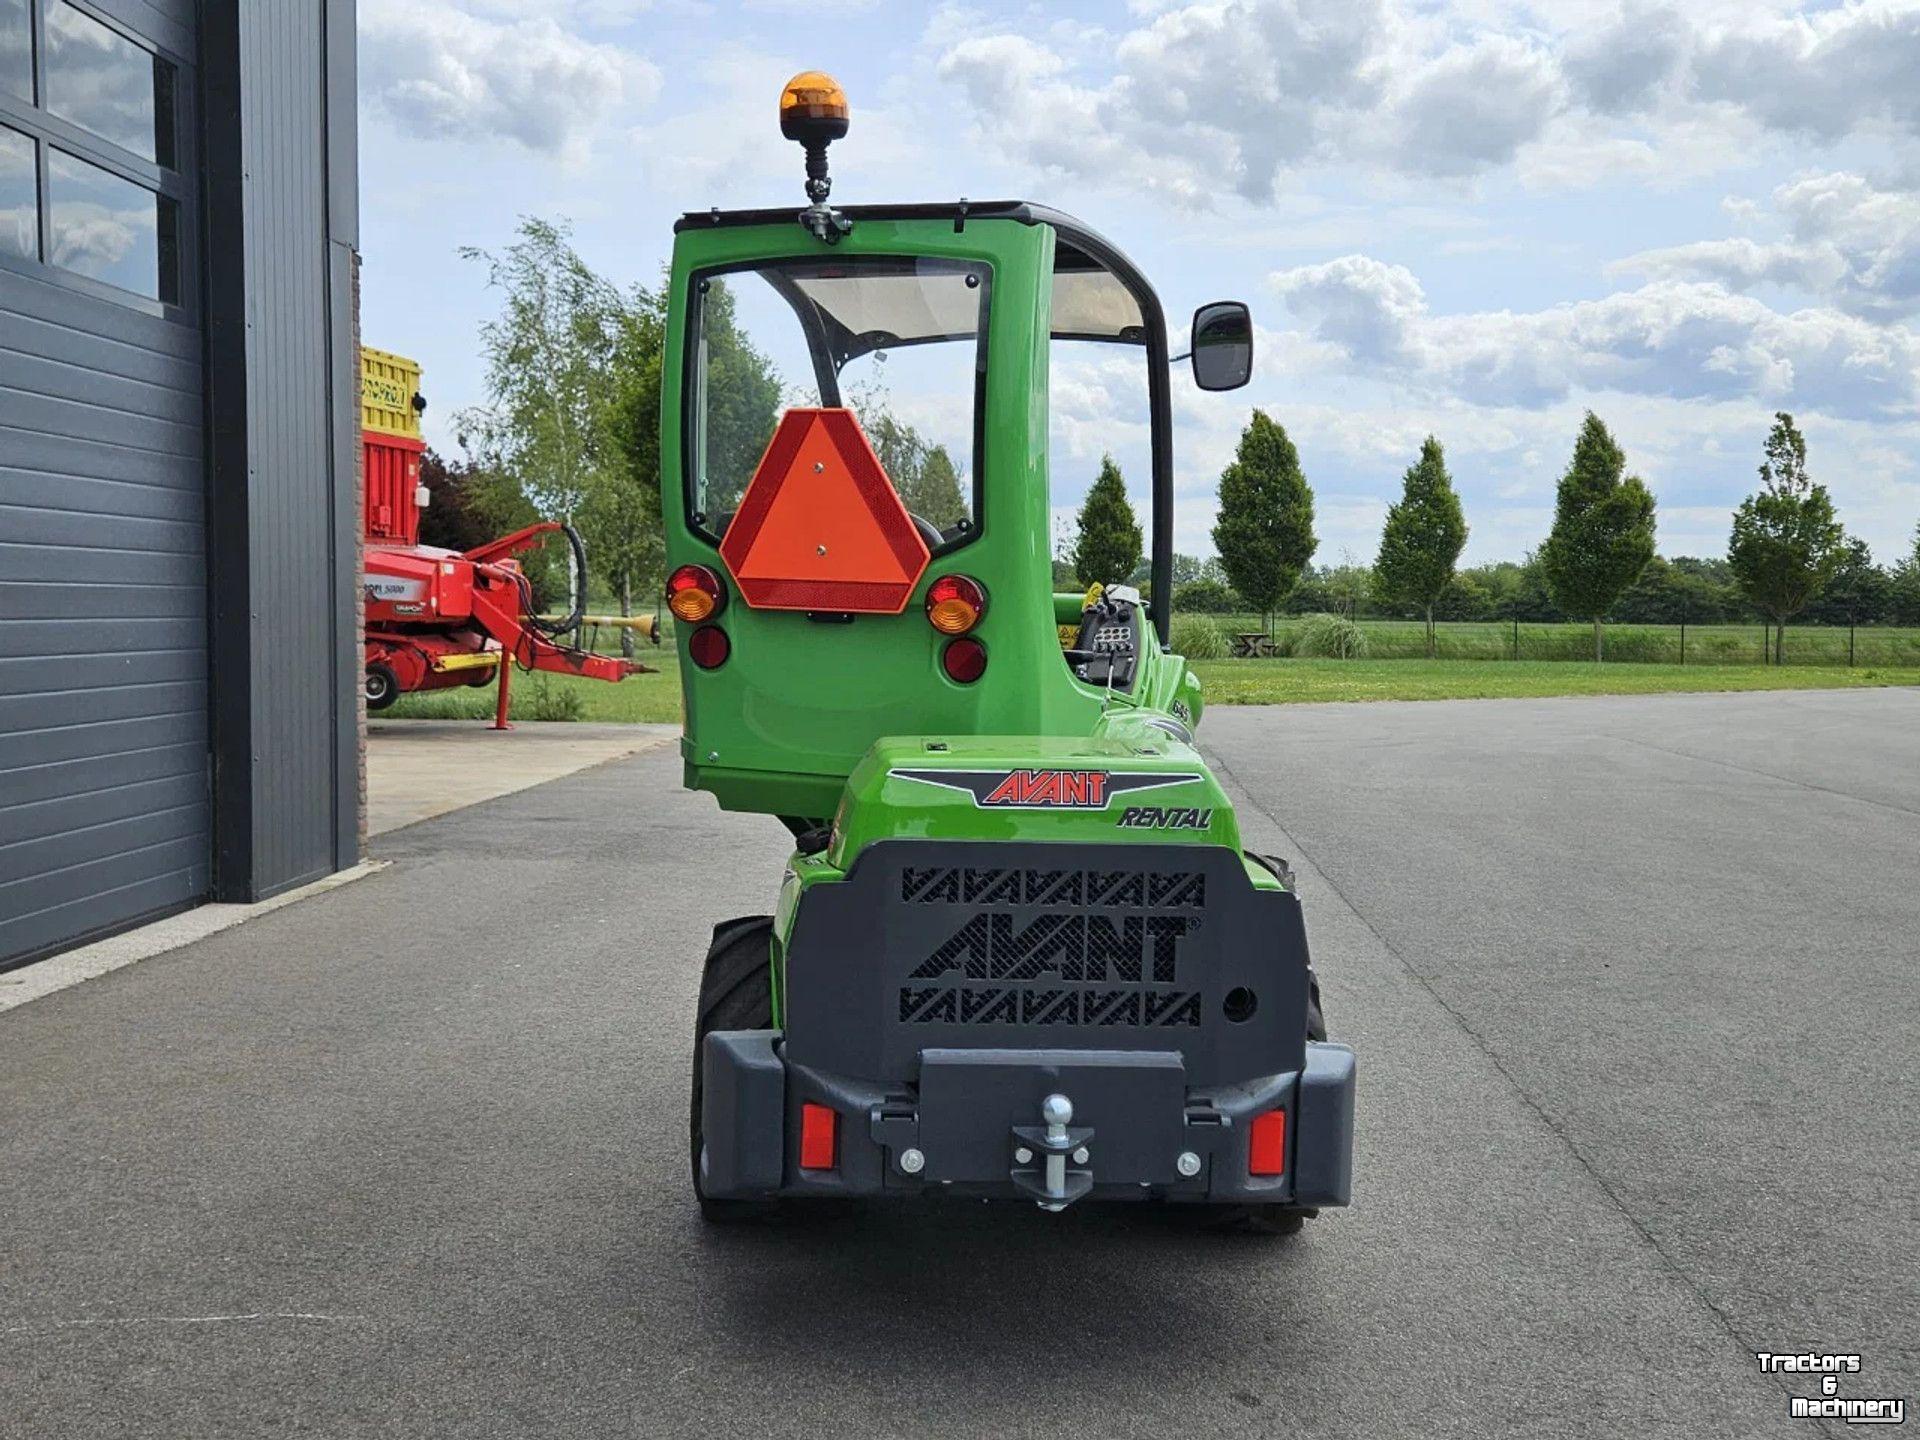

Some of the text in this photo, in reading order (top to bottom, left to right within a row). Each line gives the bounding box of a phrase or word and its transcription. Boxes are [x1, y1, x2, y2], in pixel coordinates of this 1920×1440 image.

[982, 769, 1108, 806] AVANT
[1116, 807, 1214, 831] RENTAL
[907, 912, 1186, 982] AVANT
